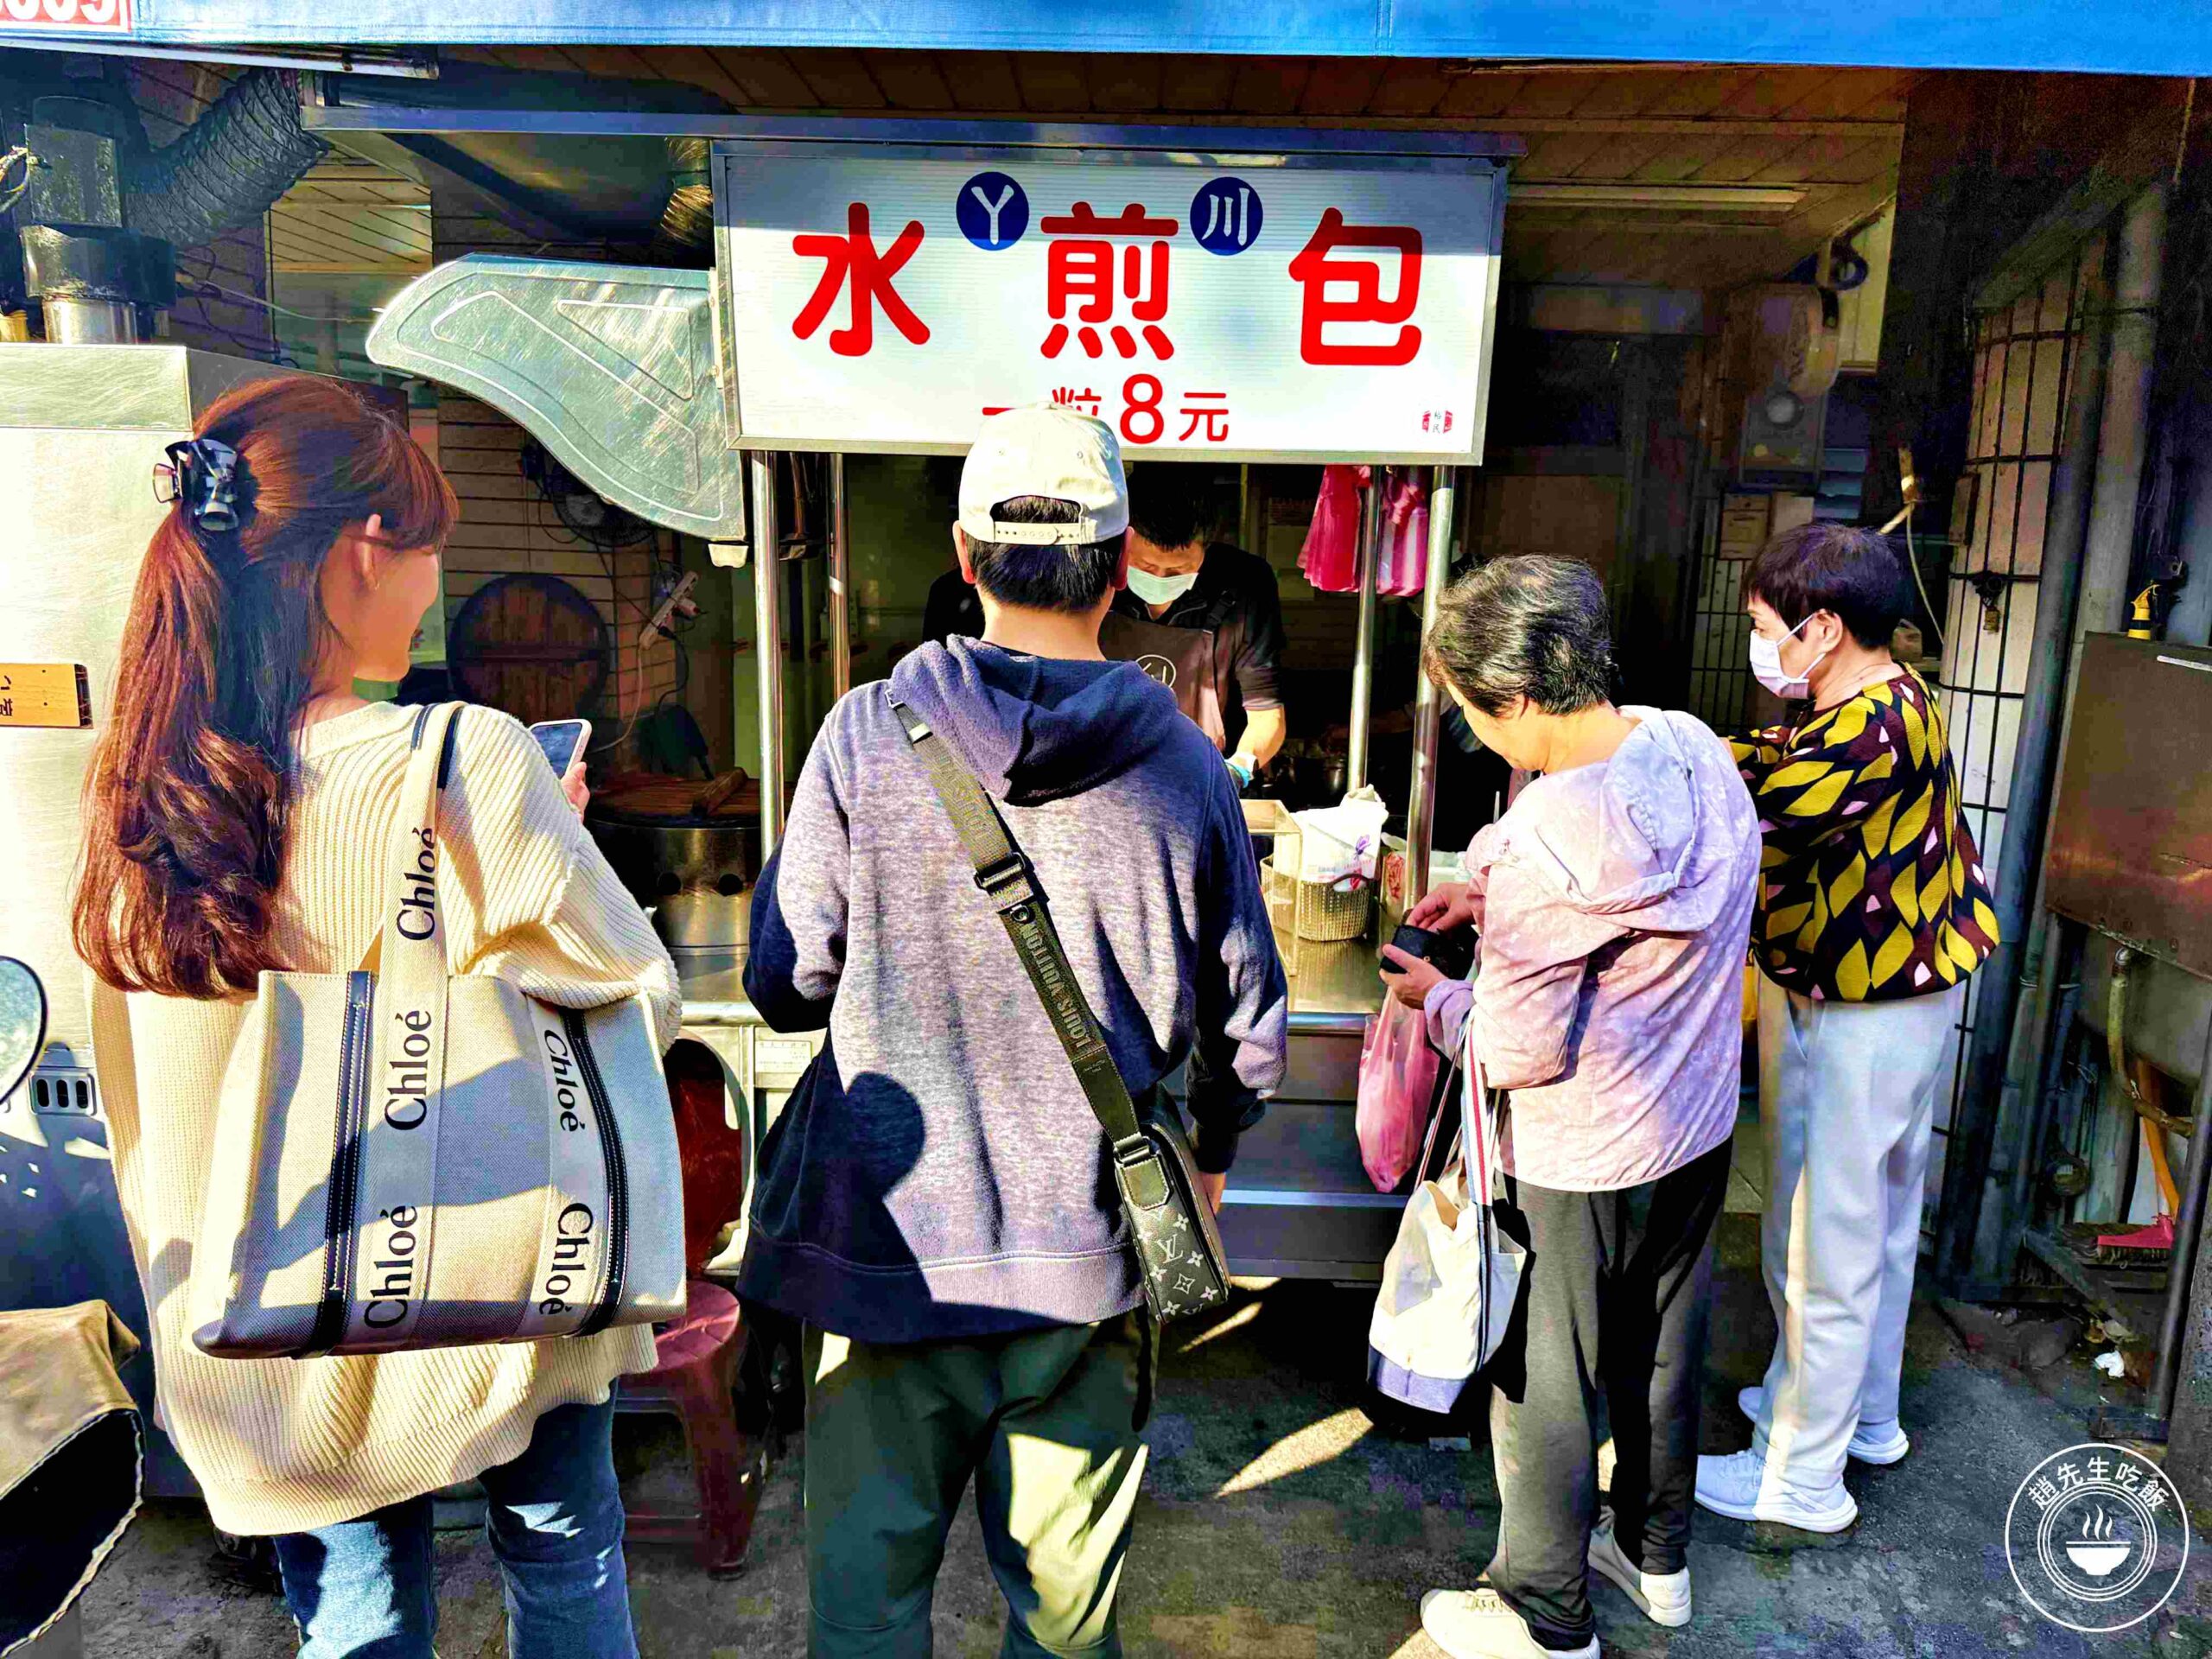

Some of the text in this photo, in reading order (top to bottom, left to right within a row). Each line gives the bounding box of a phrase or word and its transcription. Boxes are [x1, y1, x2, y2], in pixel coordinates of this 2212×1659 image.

[791, 201, 1423, 366] 水煎包
[397, 827, 435, 941] Chloé
[1020, 921, 1091, 1048] LOUIS VUITTON
[384, 1009, 432, 1131] Chloé
[544, 1028, 586, 1133] Chloé
[364, 1205, 418, 1330] Chloé
[538, 1201, 594, 1315] Chloé
